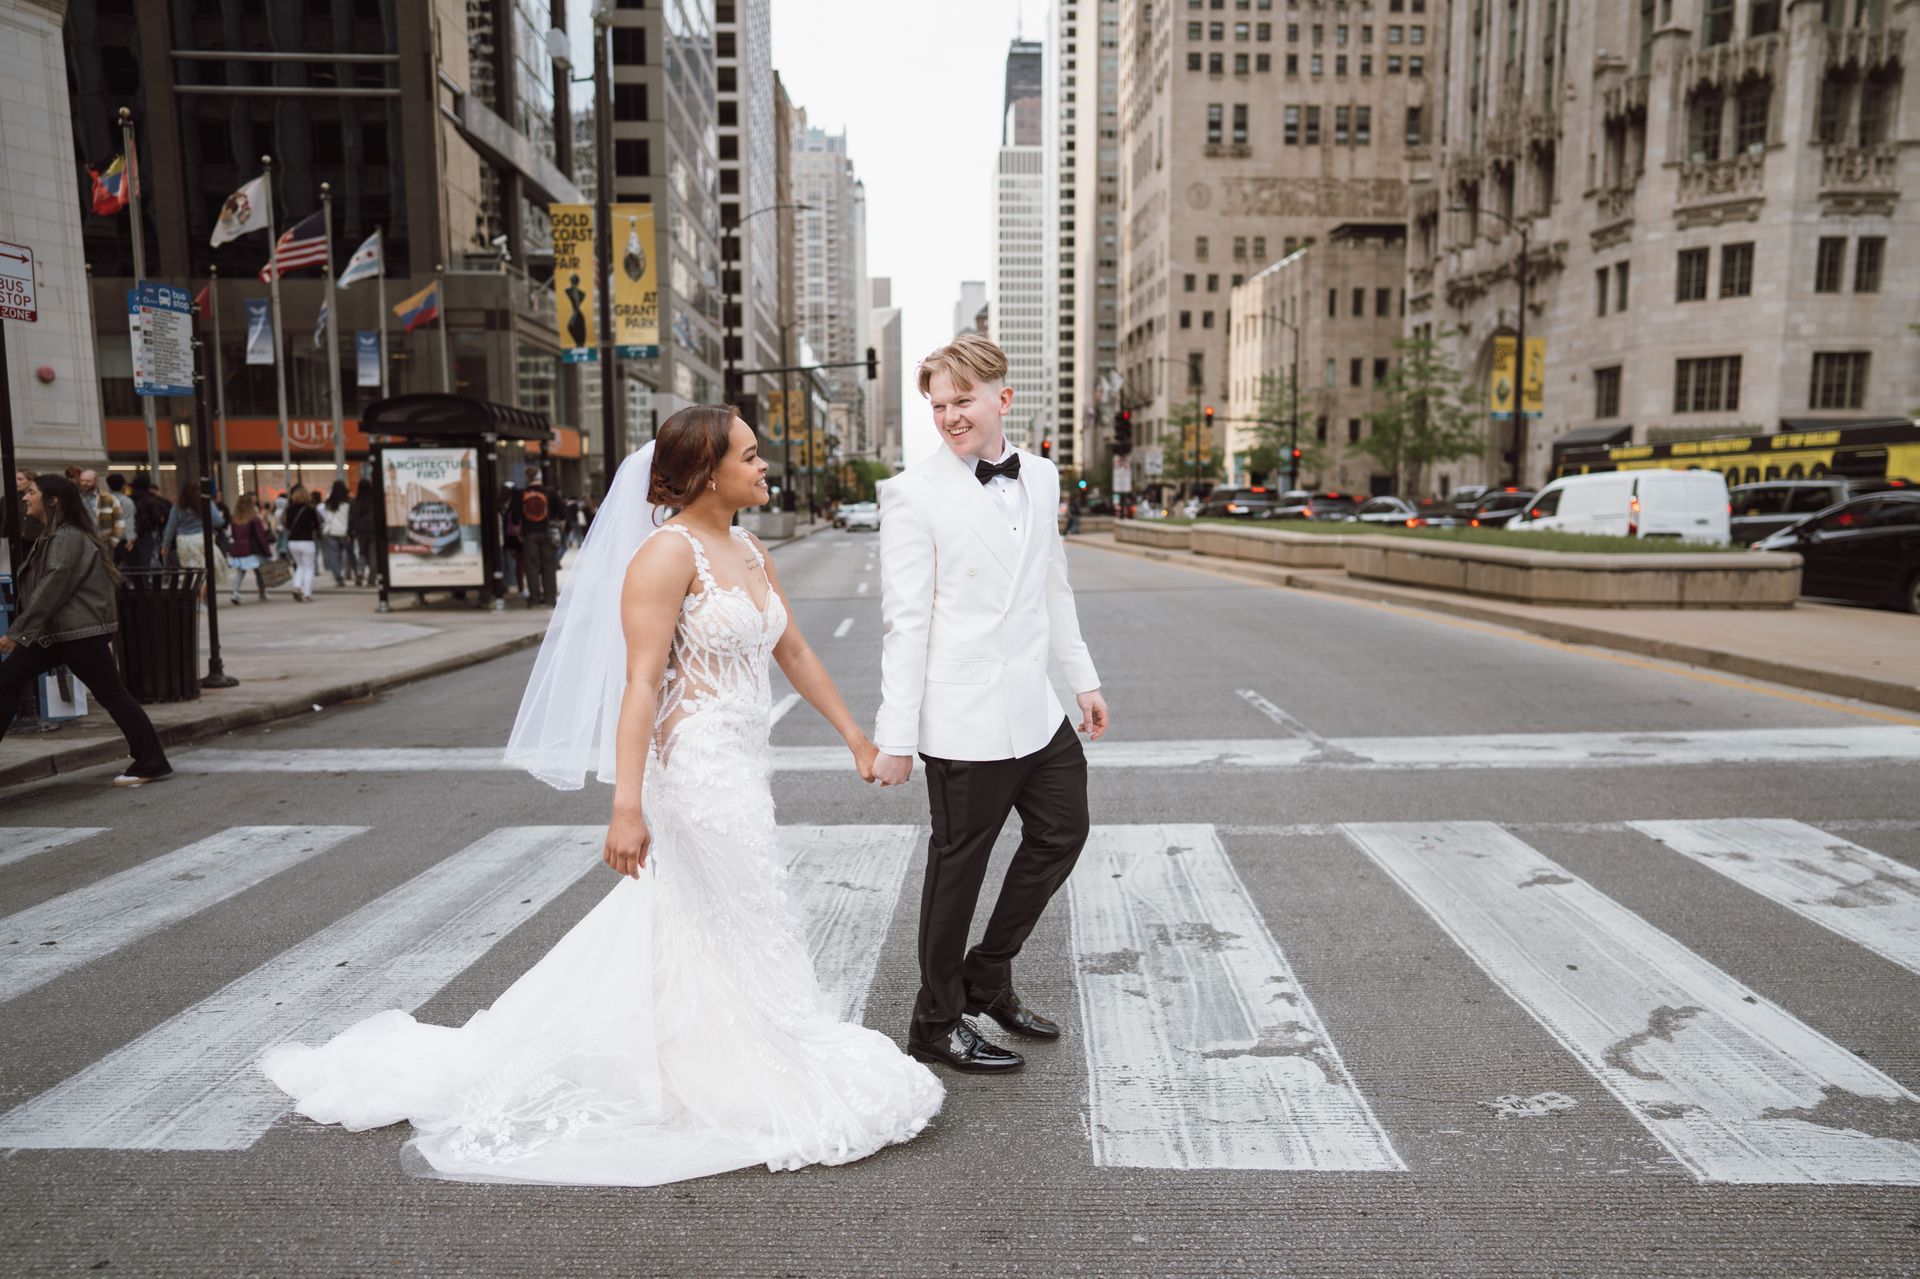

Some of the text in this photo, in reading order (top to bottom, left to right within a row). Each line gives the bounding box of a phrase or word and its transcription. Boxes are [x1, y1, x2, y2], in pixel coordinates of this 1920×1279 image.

[551, 213, 589, 227] GOLD
[551, 228, 593, 241] COAST
[553, 242, 575, 255] ART
[553, 256, 580, 269] FAIR
[172, 290, 187, 301] bus
[643, 292, 658, 303] AT
[172, 299, 190, 311] stop
[614, 304, 658, 317] GRANT
[1, 306, 32, 321] ZONE
[625, 317, 657, 329] PARK
[416, 470, 446, 480] FIRST
